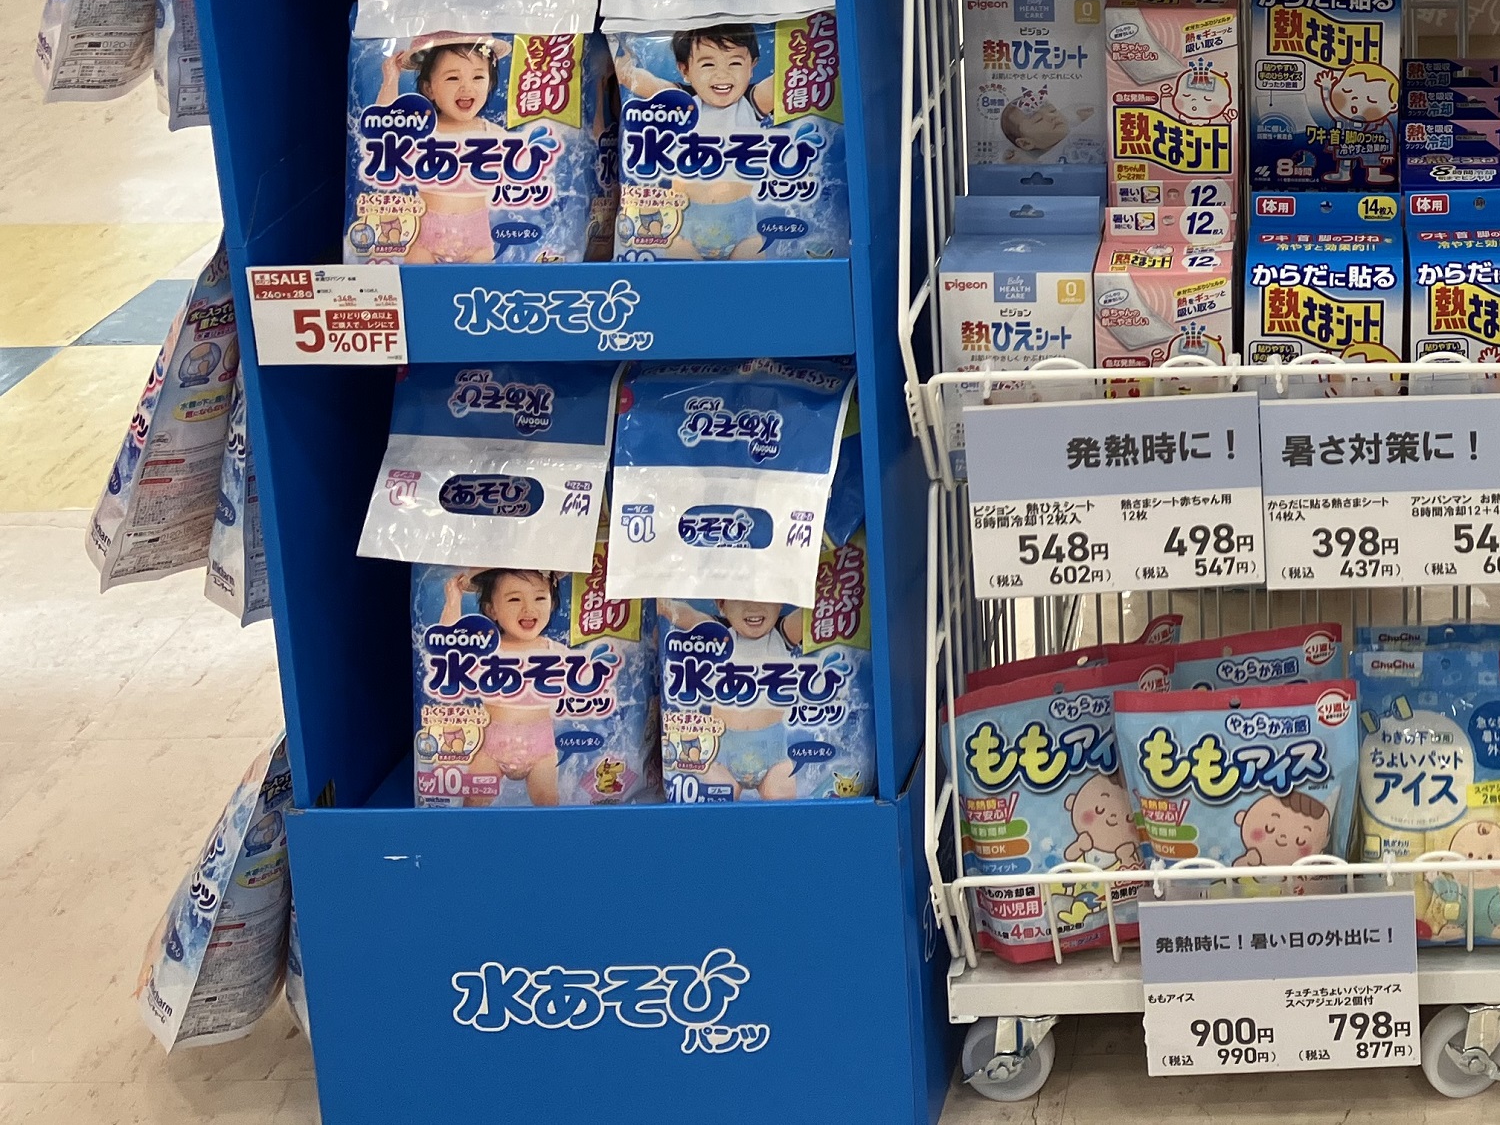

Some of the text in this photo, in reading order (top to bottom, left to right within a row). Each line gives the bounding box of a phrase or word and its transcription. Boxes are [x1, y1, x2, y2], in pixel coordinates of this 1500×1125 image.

[1025, 11, 1044, 19] CARE
[1020, 27, 1050, 36] ピジョン
[1272, 9, 1380, 64] 熱さまシート
[983, 40, 1088, 70] 熱ひえシート
[1119, 113, 1228, 170] 熱さまシート
[364, 132, 550, 183] 水あそび
[625, 131, 814, 180] 水あそび
[491, 183, 549, 204] パンツ
[1261, 198, 1289, 214] 体用
[1113, 214, 1135, 223] 暑い
[271, 273, 308, 285] SALE
[1253, 264, 1395, 288] からだに貼る
[1000, 285, 1031, 293] HEALTH
[454, 287, 640, 334] 水あそび
[1000, 308, 1032, 317] ピジョン
[1268, 288, 1380, 343] 熱さまシート
[962, 321, 1072, 351] 熱ひえシート
[1065, 428, 1238, 470] 発熱時に！
[1281, 429, 1480, 466] 暑さ対策に！
[972, 499, 1095, 518] ピジョン 熱ひえシート
[1121, 493, 1233, 510] 熱さまシート赤ちゃん用
[1267, 496, 1390, 511] からだに貼る熱さまシート
[1410, 494, 1472, 507] アンパンマン
[1121, 510, 1148, 522] 12枚
[1017, 532, 1110, 565] 548円
[1164, 525, 1255, 558] 498円
[1312, 525, 1400, 559] 398円
[426, 651, 610, 700] 水あそび
[1371, 659, 1415, 670] ChuChu
[669, 658, 843, 706] 水あそび
[555, 694, 613, 718] パンツ
[1227, 714, 1311, 738] やわらか冷感
[1139, 722, 1332, 802] ももアイス
[1370, 749, 1464, 769] ちょいパット
[1373, 773, 1458, 806] アイス
[1156, 928, 1393, 953] 発熱時に！暑い日の外出に！
[1148, 993, 1195, 1004] ももアイス
[1190, 1017, 1274, 1047] 900円
[1328, 1011, 1411, 1041] 798円
